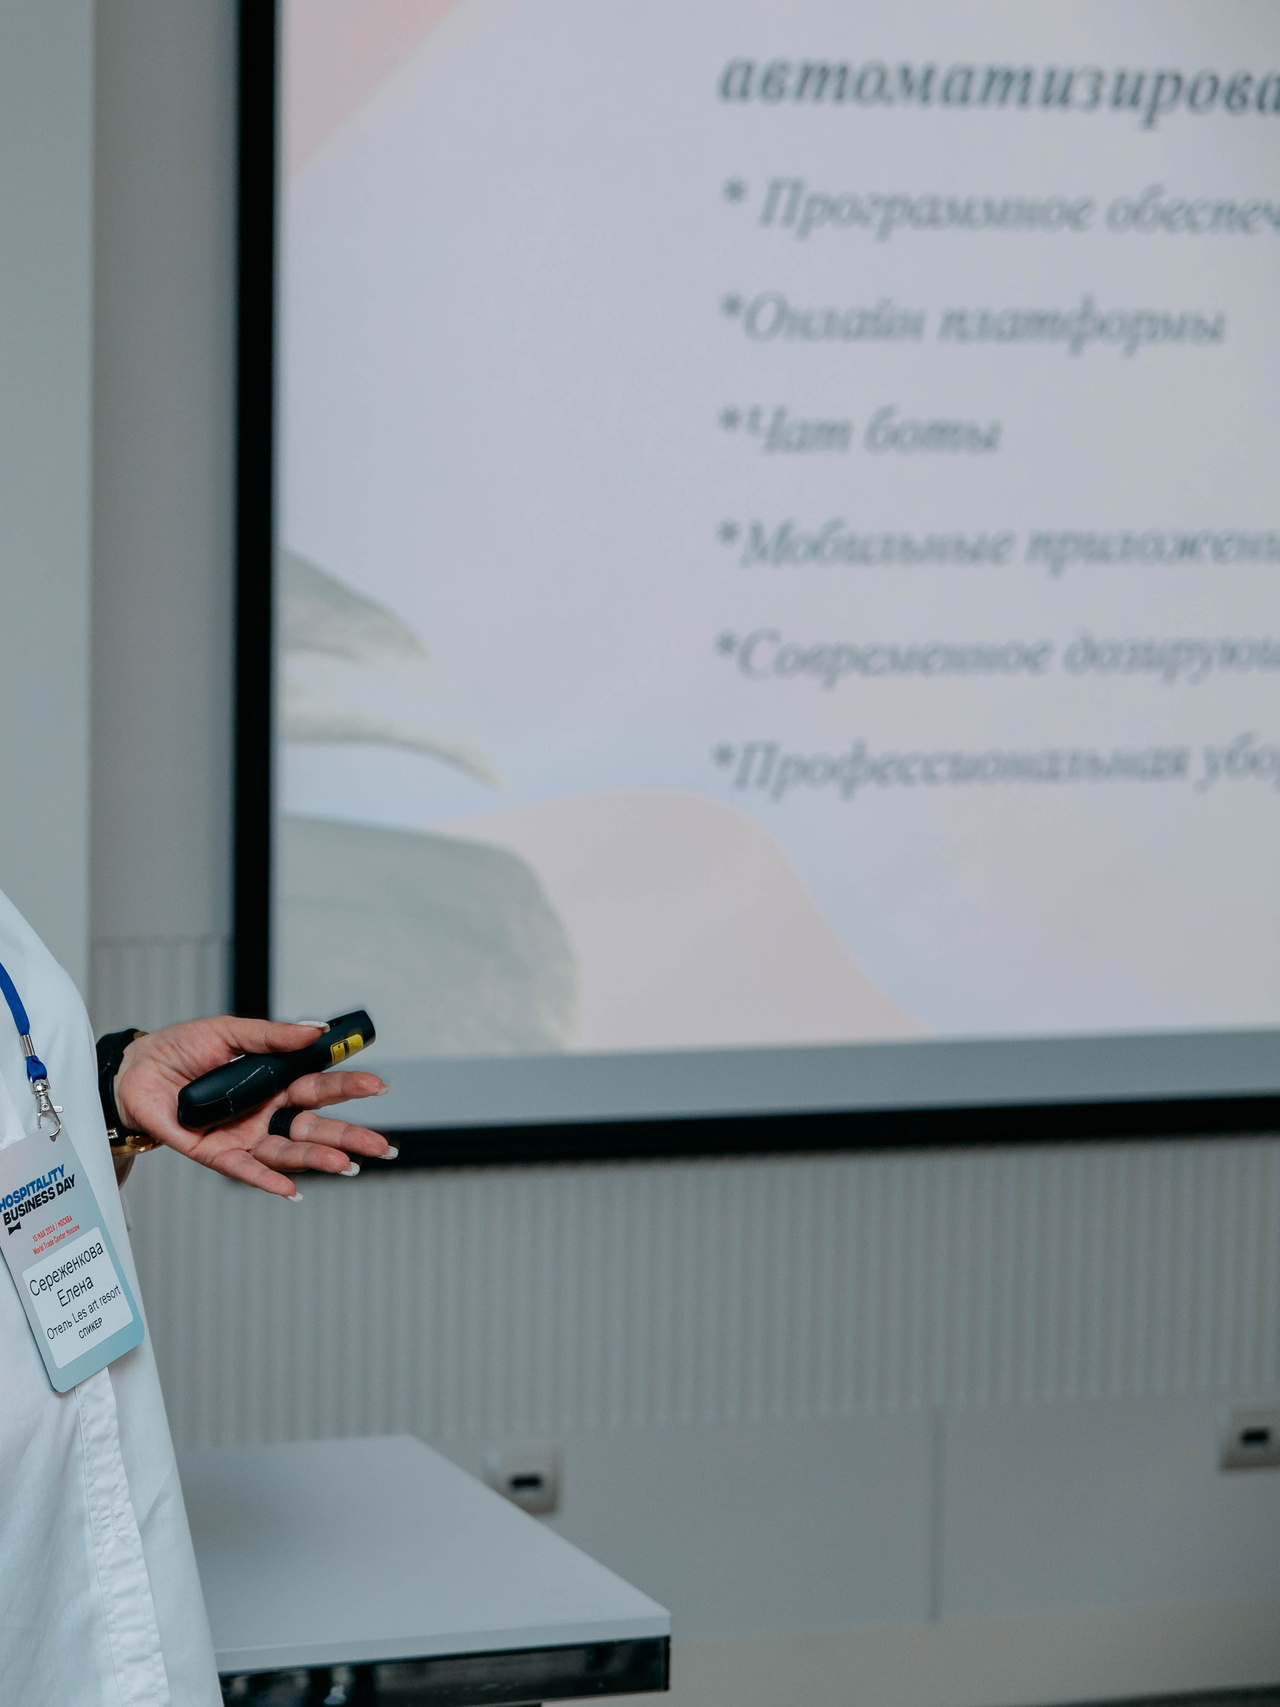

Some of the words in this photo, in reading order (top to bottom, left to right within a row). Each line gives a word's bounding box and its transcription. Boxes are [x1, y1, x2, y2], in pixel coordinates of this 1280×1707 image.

[718, 56, 1280, 130] автоматизирова
[758, 176, 1098, 241] Программное
[935, 292, 1226, 358] платформы
[862, 403, 1003, 454] боты
[1193, 730, 1280, 794] убо
[2, 1186, 57, 1226] BUSINESS
[56, 1173, 77, 1196] DAY
[29, 1241, 104, 1297] Сереженкова
[56, 1275, 95, 1308] Елена
[46, 1320, 74, 1341] Отель
[72, 1308, 88, 1324] Les
[87, 1299, 101, 1314] art
[99, 1284, 121, 1306] resort
